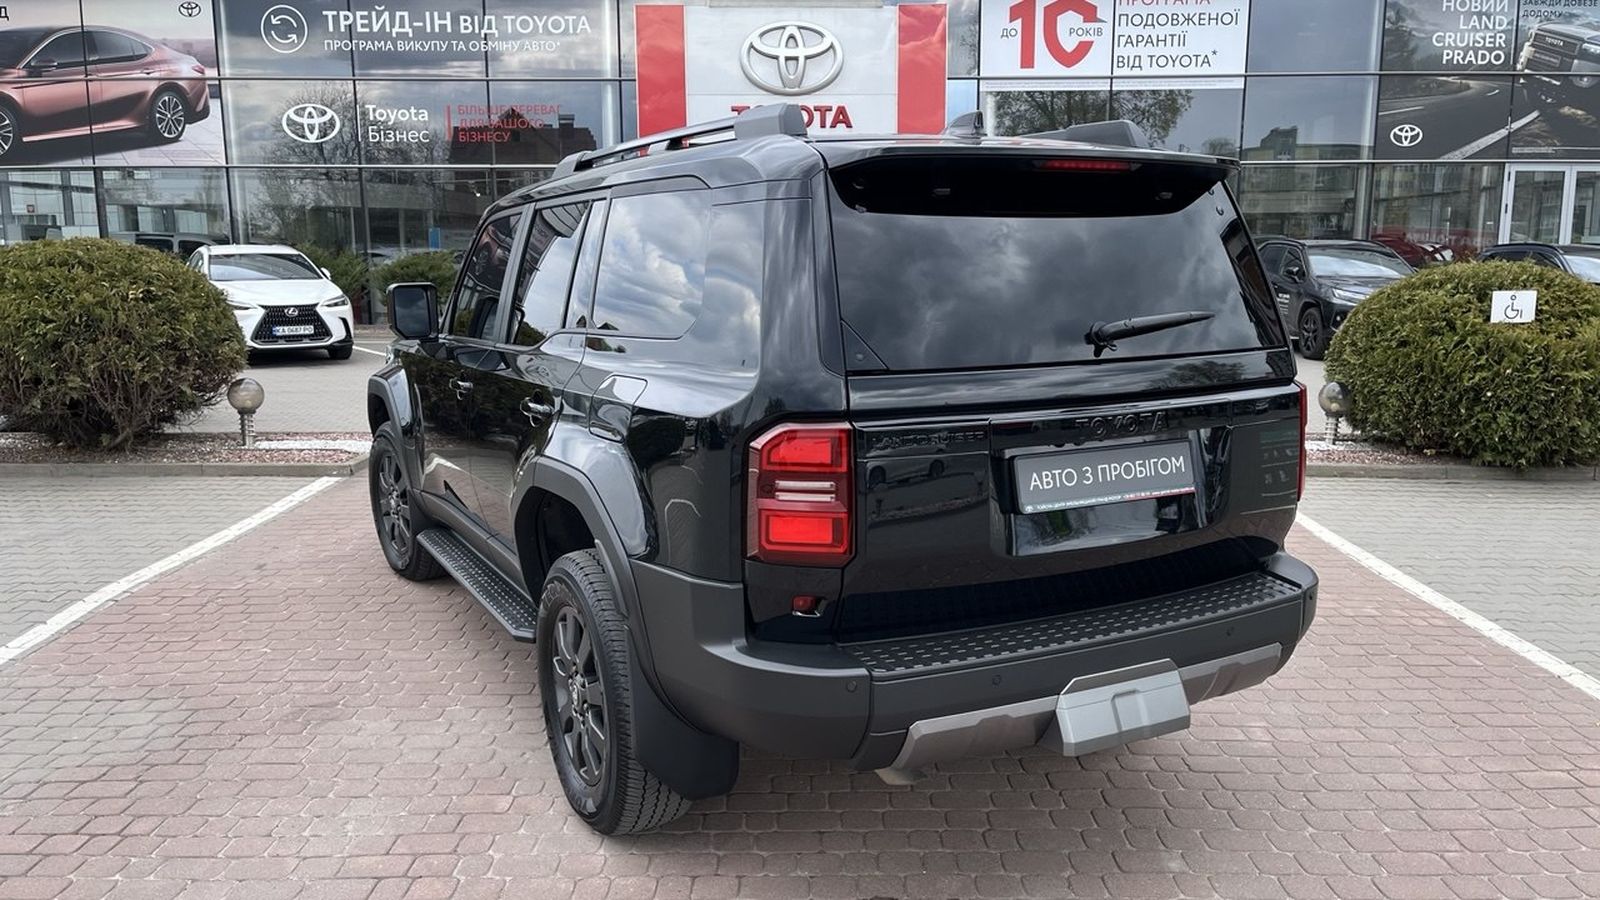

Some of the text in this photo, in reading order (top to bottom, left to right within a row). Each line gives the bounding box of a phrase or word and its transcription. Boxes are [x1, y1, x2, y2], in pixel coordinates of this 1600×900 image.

[323, 6, 591, 37] ТРЕЙД-ІН ВІД TOYOTA
[1118, 9, 1240, 29] ПОДОВЖЕНОЇ
[1522, 10, 1563, 18] ДОДОМУ
[1459, 16, 1507, 29] LAND
[1000, 28, 1018, 38] ДО
[1069, 27, 1103, 37] РОКІВ
[1117, 31, 1187, 48] ГАРАНТІЇ
[1432, 32, 1506, 47] CRUISER
[324, 40, 394, 51] ПРОГРАМА
[397, 40, 447, 51] ВИКУПУ
[451, 40, 467, 51] ТА
[469, 40, 520, 51] ОБМІНУ
[1117, 55, 1142, 70] ВІД
[1442, 51, 1505, 64] PRADO
[365, 105, 429, 125] Toyota
[368, 126, 430, 143] Бізнес
[458, 131, 511, 142] БІЗНЕСУ
[1074, 410, 1169, 437] TOYOTA
[1030, 455, 1186, 491] АВТО З ПРОБІГОМ
